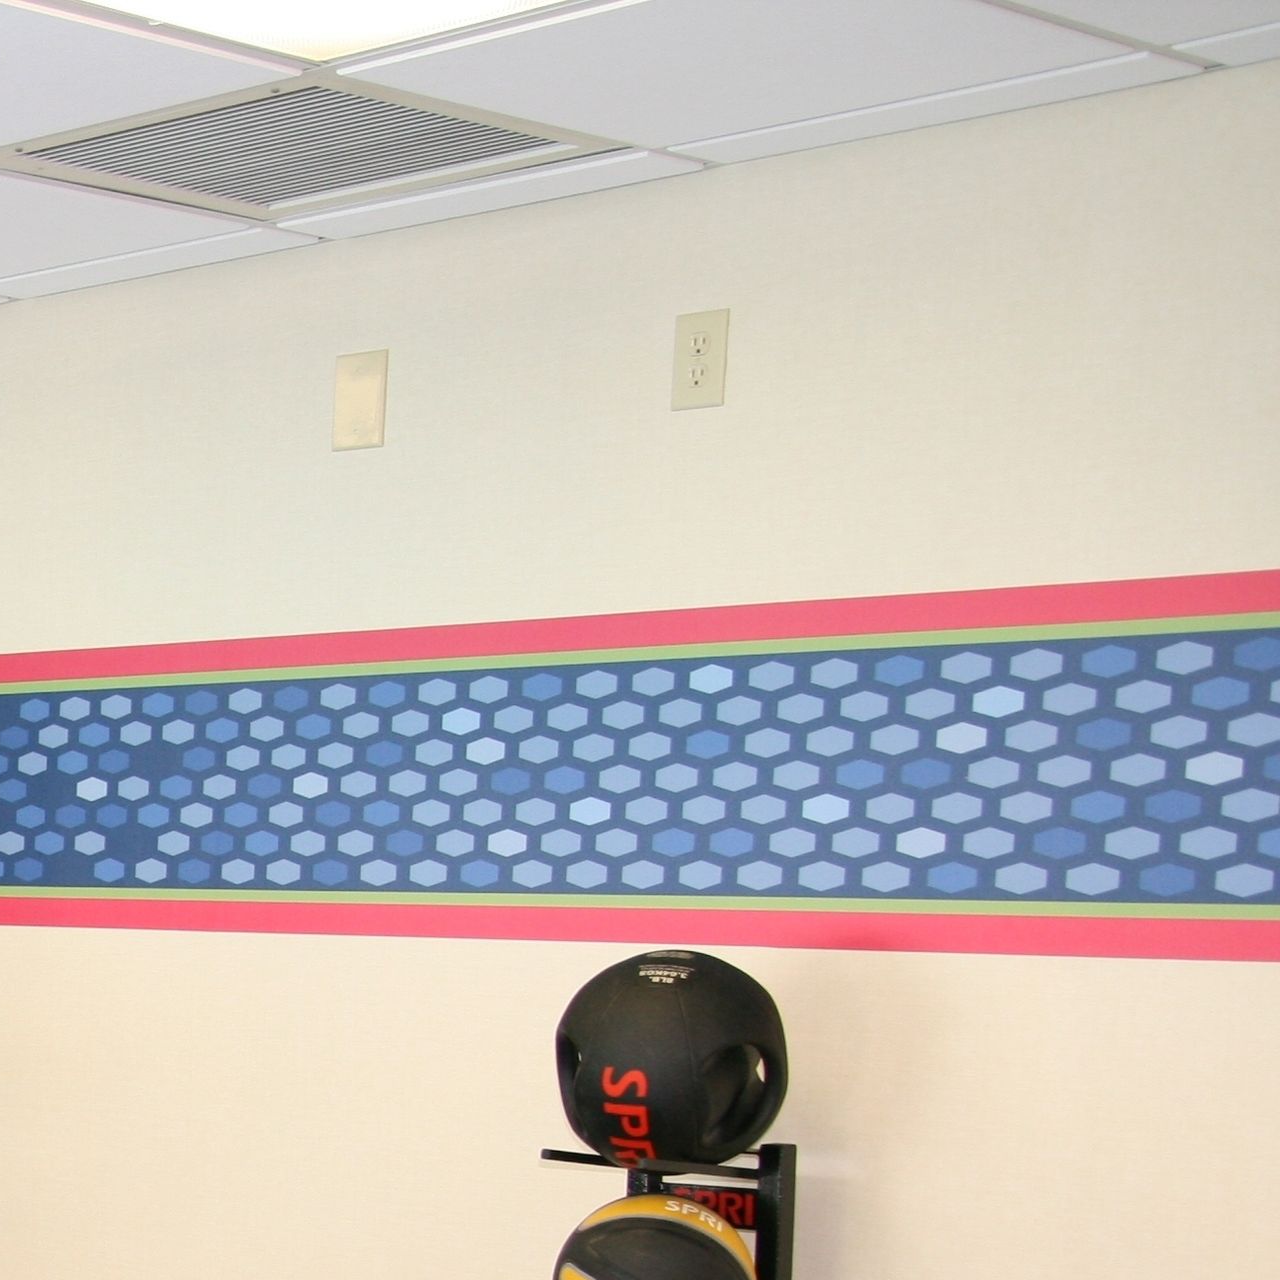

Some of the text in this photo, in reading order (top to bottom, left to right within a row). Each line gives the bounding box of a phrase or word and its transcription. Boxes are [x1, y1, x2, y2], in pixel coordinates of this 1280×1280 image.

[602, 1066, 657, 1169] SPR
[664, 1200, 723, 1232] SPRI
[673, 1186, 754, 1226] PRI
